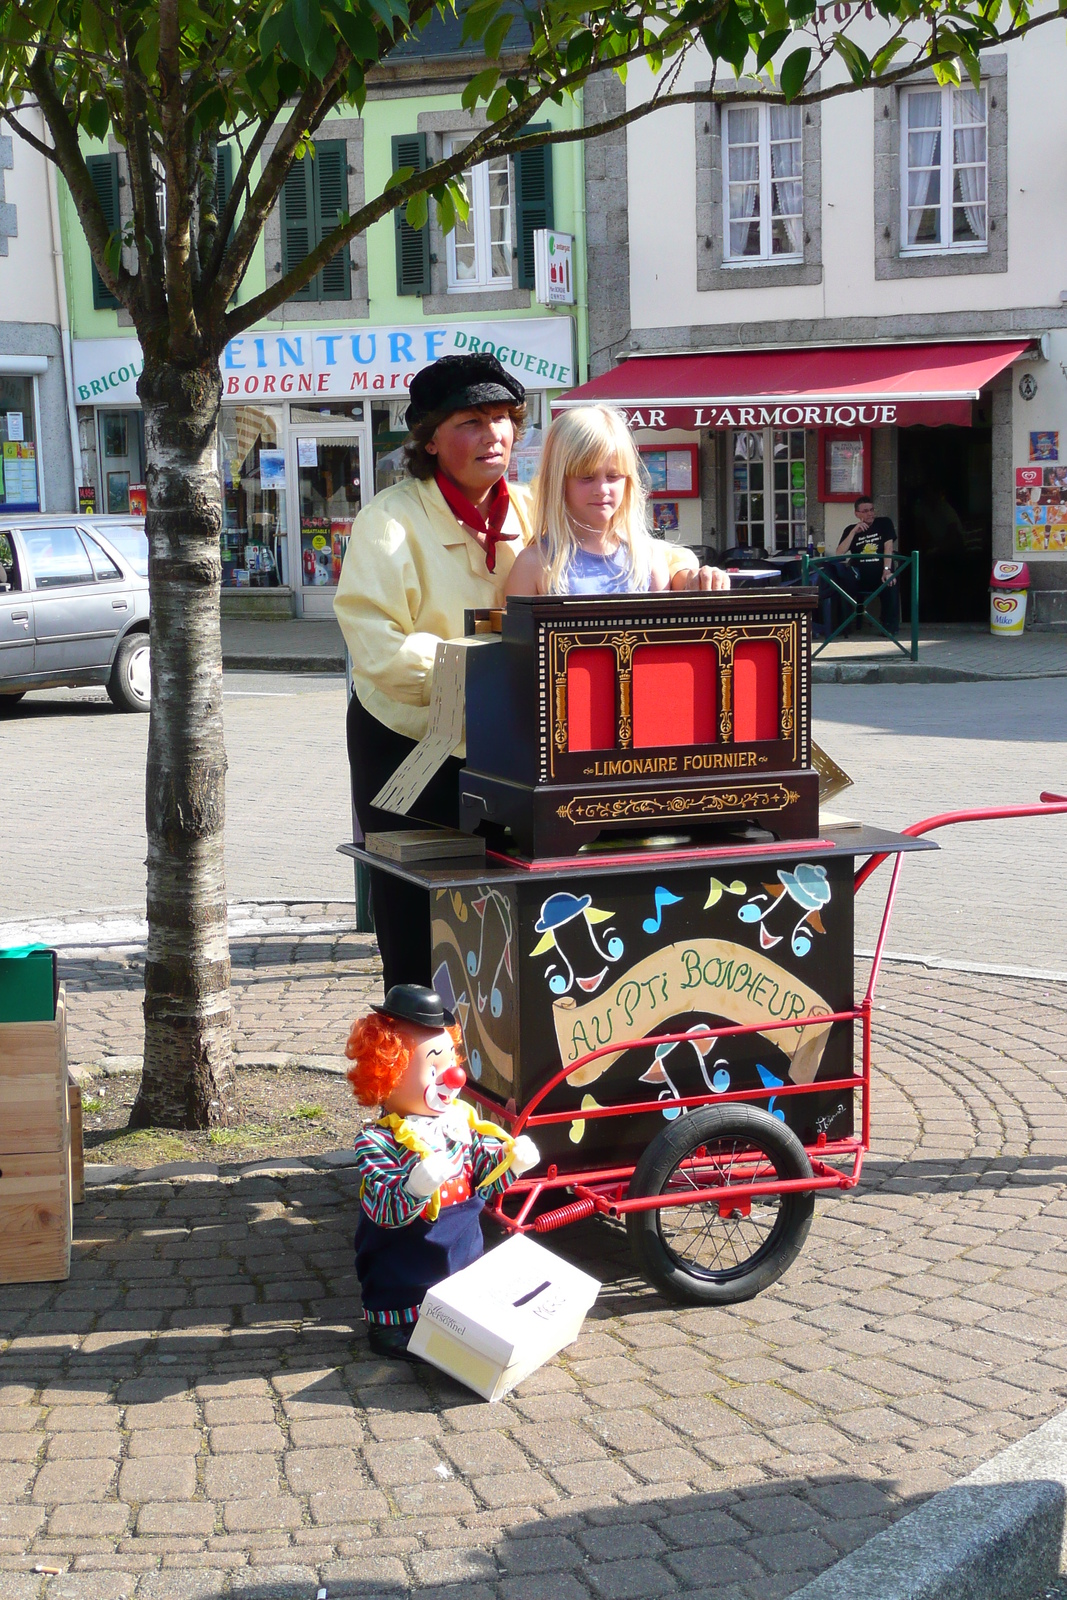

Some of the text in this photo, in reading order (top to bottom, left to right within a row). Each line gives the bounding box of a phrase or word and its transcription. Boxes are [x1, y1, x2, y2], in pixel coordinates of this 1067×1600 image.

[225, 330, 447, 370] EINTURE
[453, 331, 571, 384] DROGUERIE
[226, 373, 331, 395] BORGNE
[694, 405, 898, 428] L'ARMORIQUE
[994, 615, 1013, 625] Miko
[594, 752, 758, 777] LIMONAIRE FOURNIER
[568, 1008, 612, 1060] AU
[680, 949, 806, 1033] BONHEUR
[426, 1308, 466, 1336] personnel
